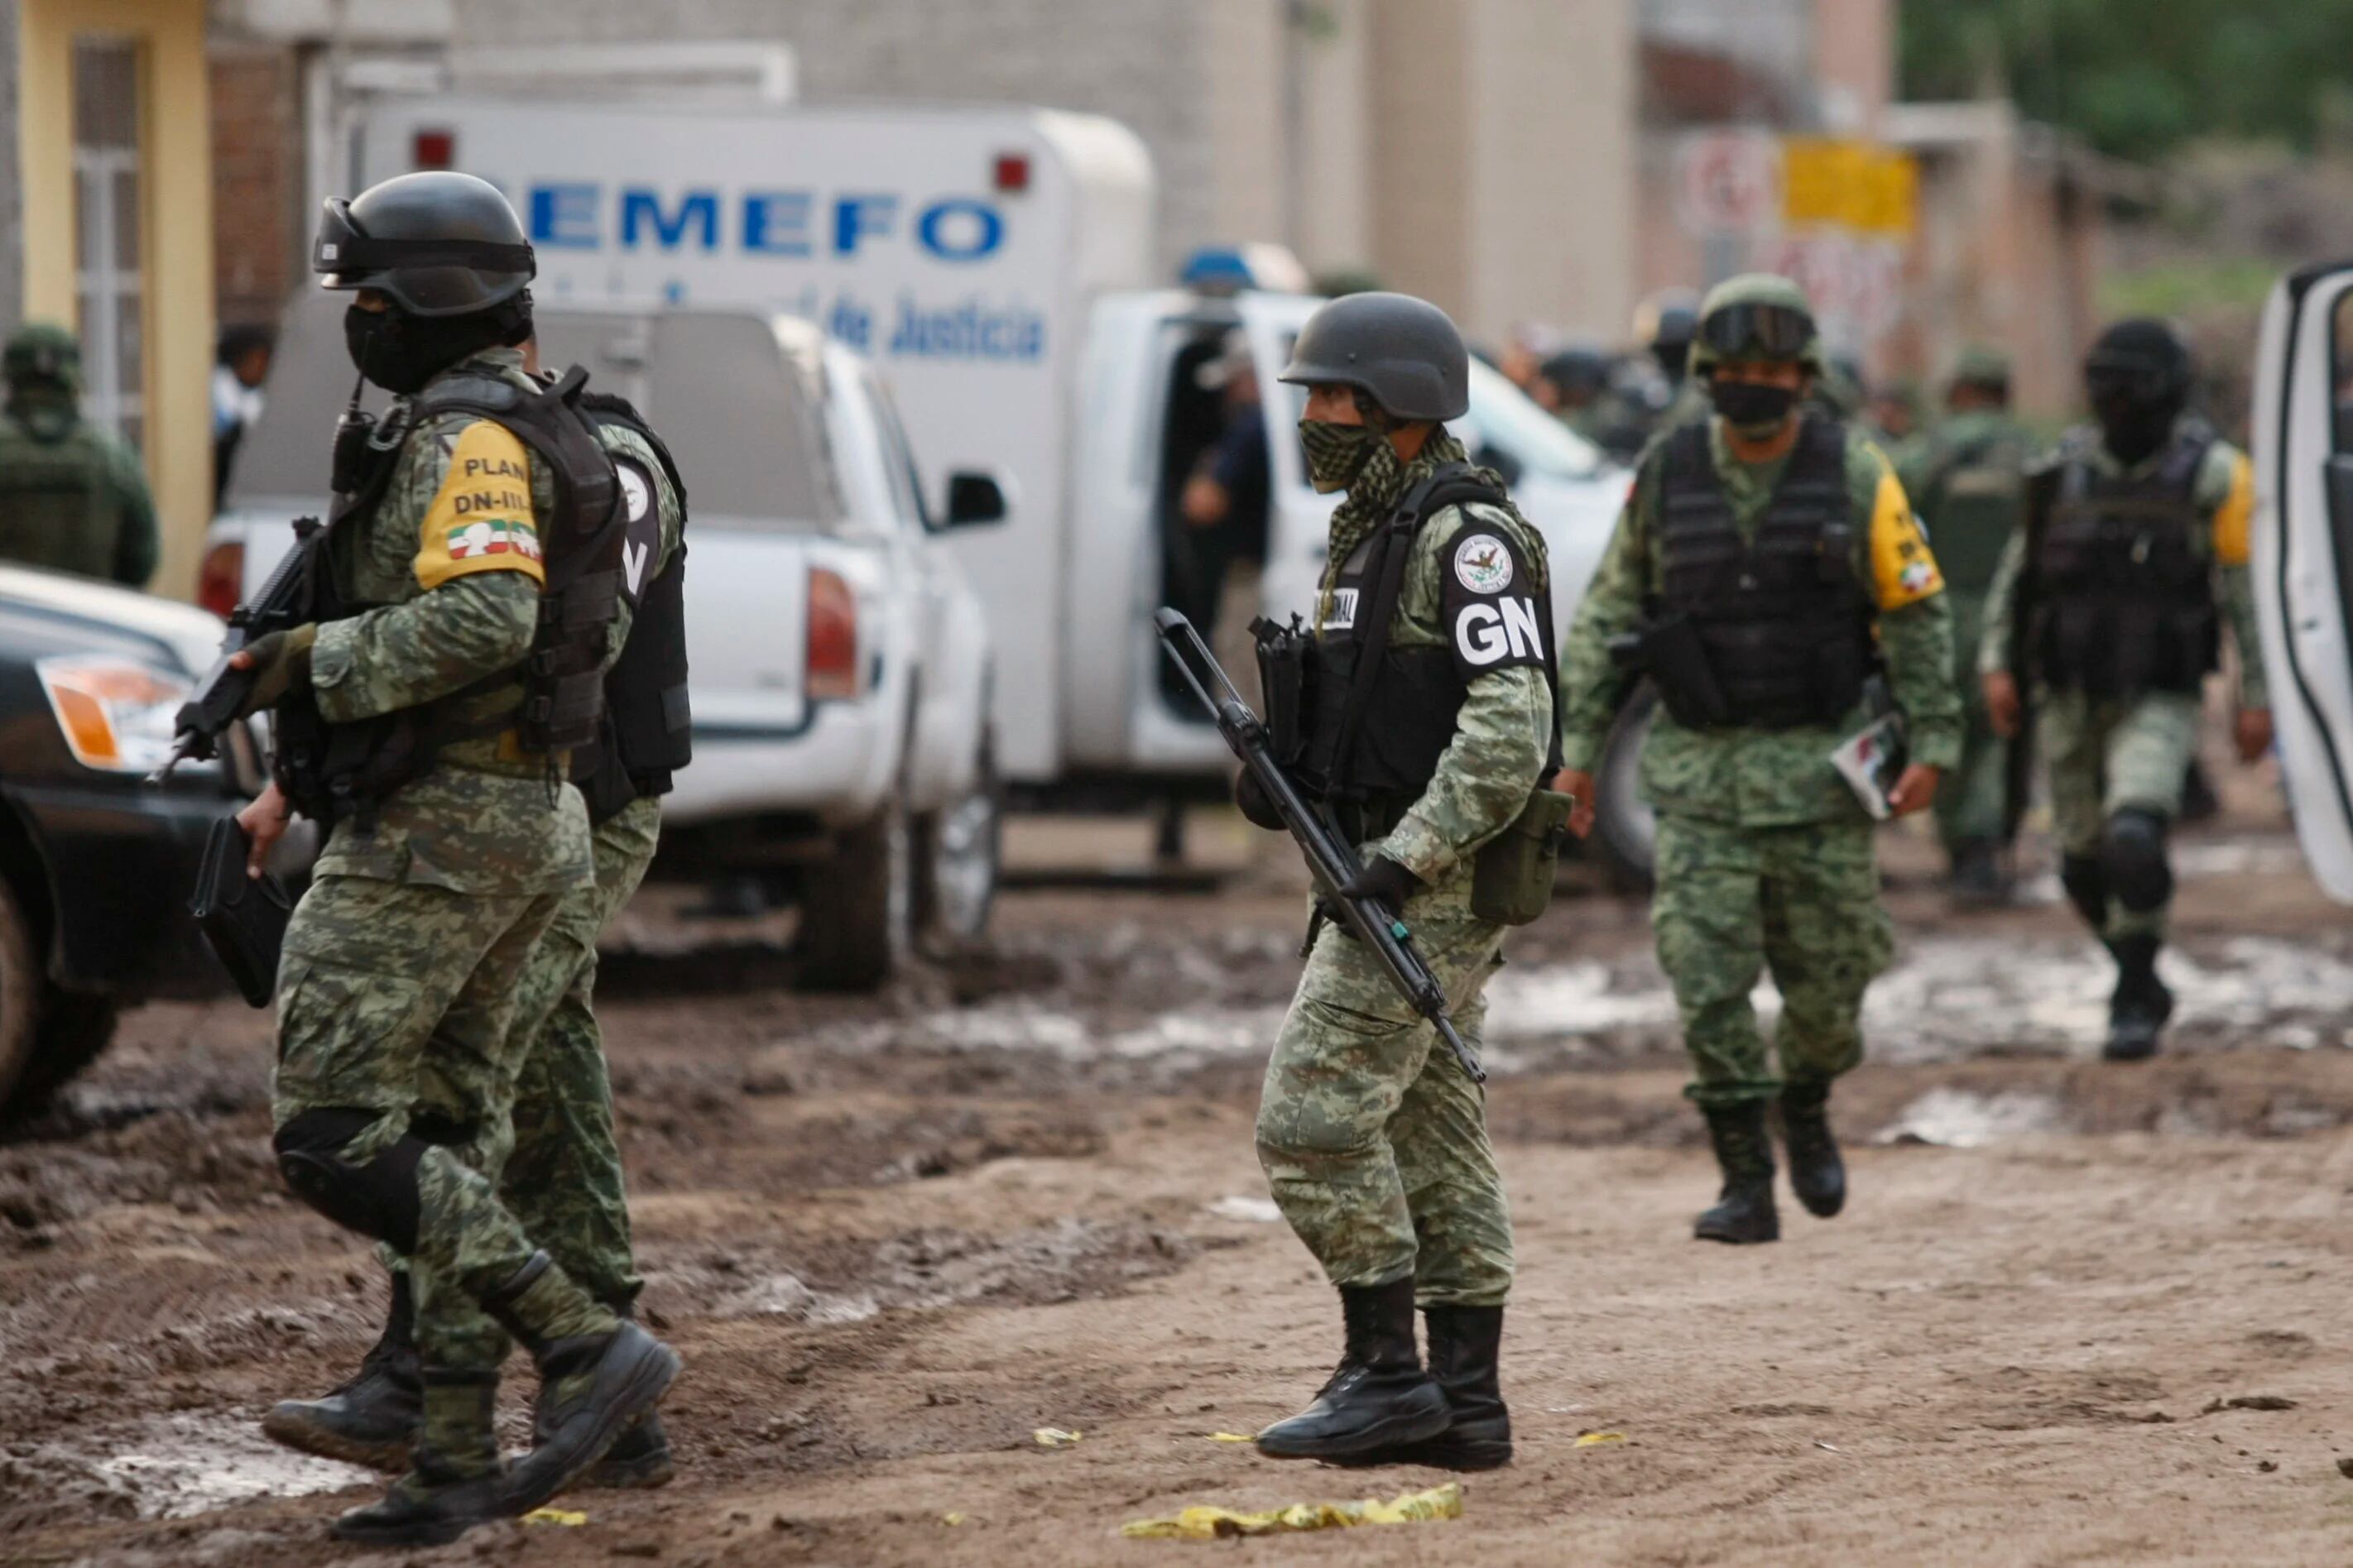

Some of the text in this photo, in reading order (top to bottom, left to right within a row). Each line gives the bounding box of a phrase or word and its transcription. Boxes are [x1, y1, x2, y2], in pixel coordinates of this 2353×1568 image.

[526, 183, 1007, 261] EMEFO
[464, 458, 526, 482] PLAN
[1455, 597, 1544, 665] GN
